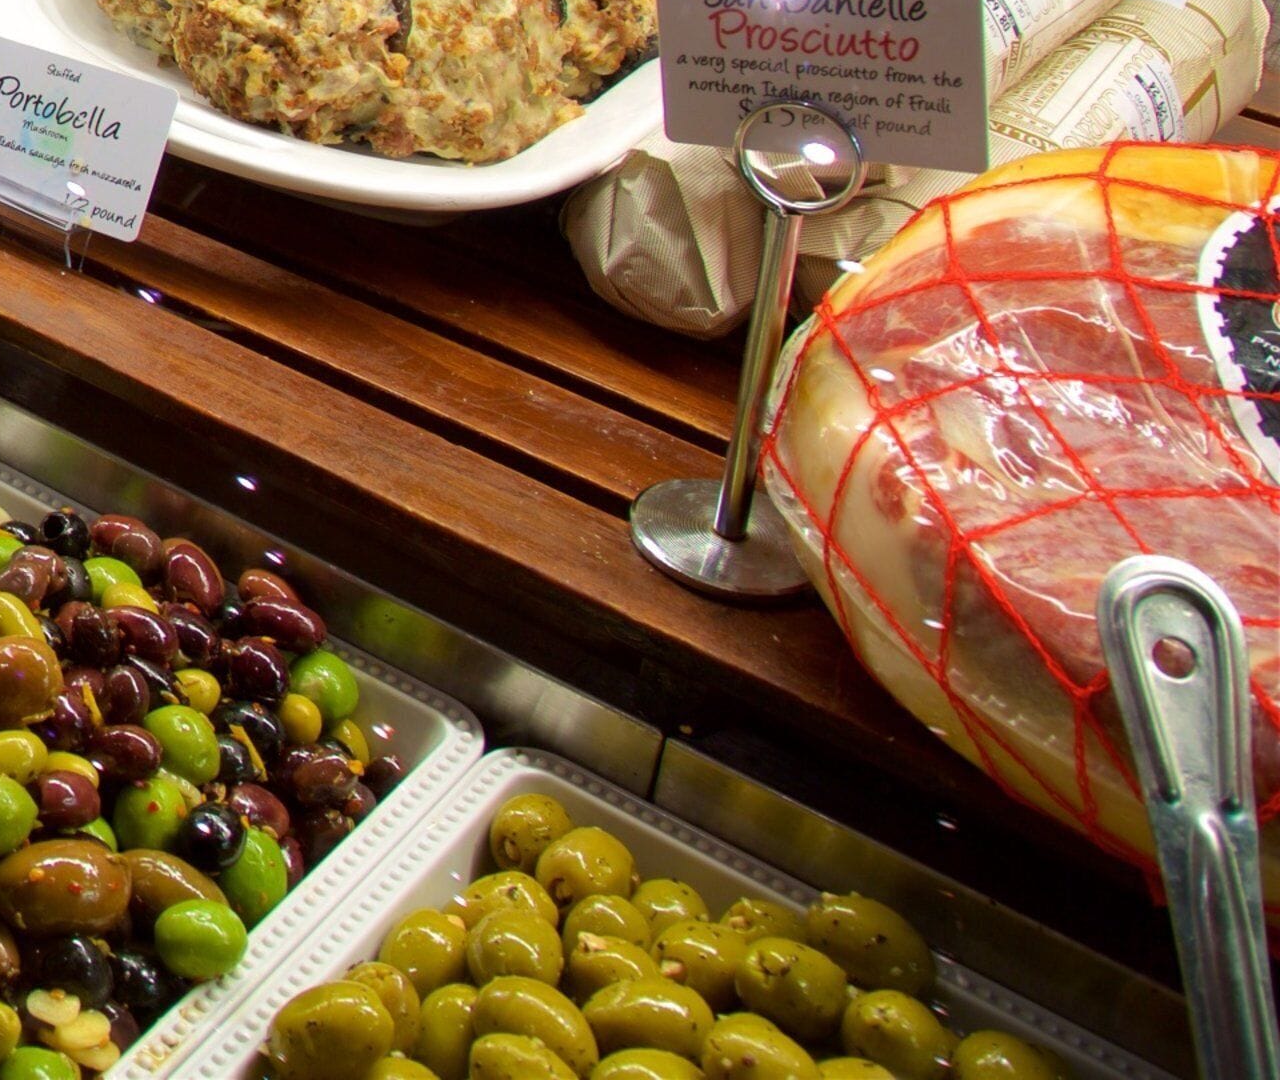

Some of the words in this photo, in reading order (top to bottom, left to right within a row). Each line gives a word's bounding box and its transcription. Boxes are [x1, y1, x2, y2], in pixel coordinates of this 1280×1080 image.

[709, 7, 919, 62] Prosciutto
[47, 64, 82, 84] Stuffed
[676, 54, 688, 65] a
[691, 55, 726, 74] very
[730, 57, 790, 75] special
[796, 61, 879, 83] prosciutto
[886, 67, 925, 87] from
[932, 71, 963, 88] the
[689, 78, 757, 97] northern
[762, 80, 822, 102] Italian
[828, 91, 880, 112] region
[885, 93, 905, 109] of
[908, 94, 953, 115] Fruili
[22, 119, 69, 142] Mushroom
[801, 112, 825, 129] per
[875, 119, 931, 136] pound
[28, 149, 65, 168] sausage
[91, 169, 142, 192] mozzarella
[90, 205, 137, 229] pound
